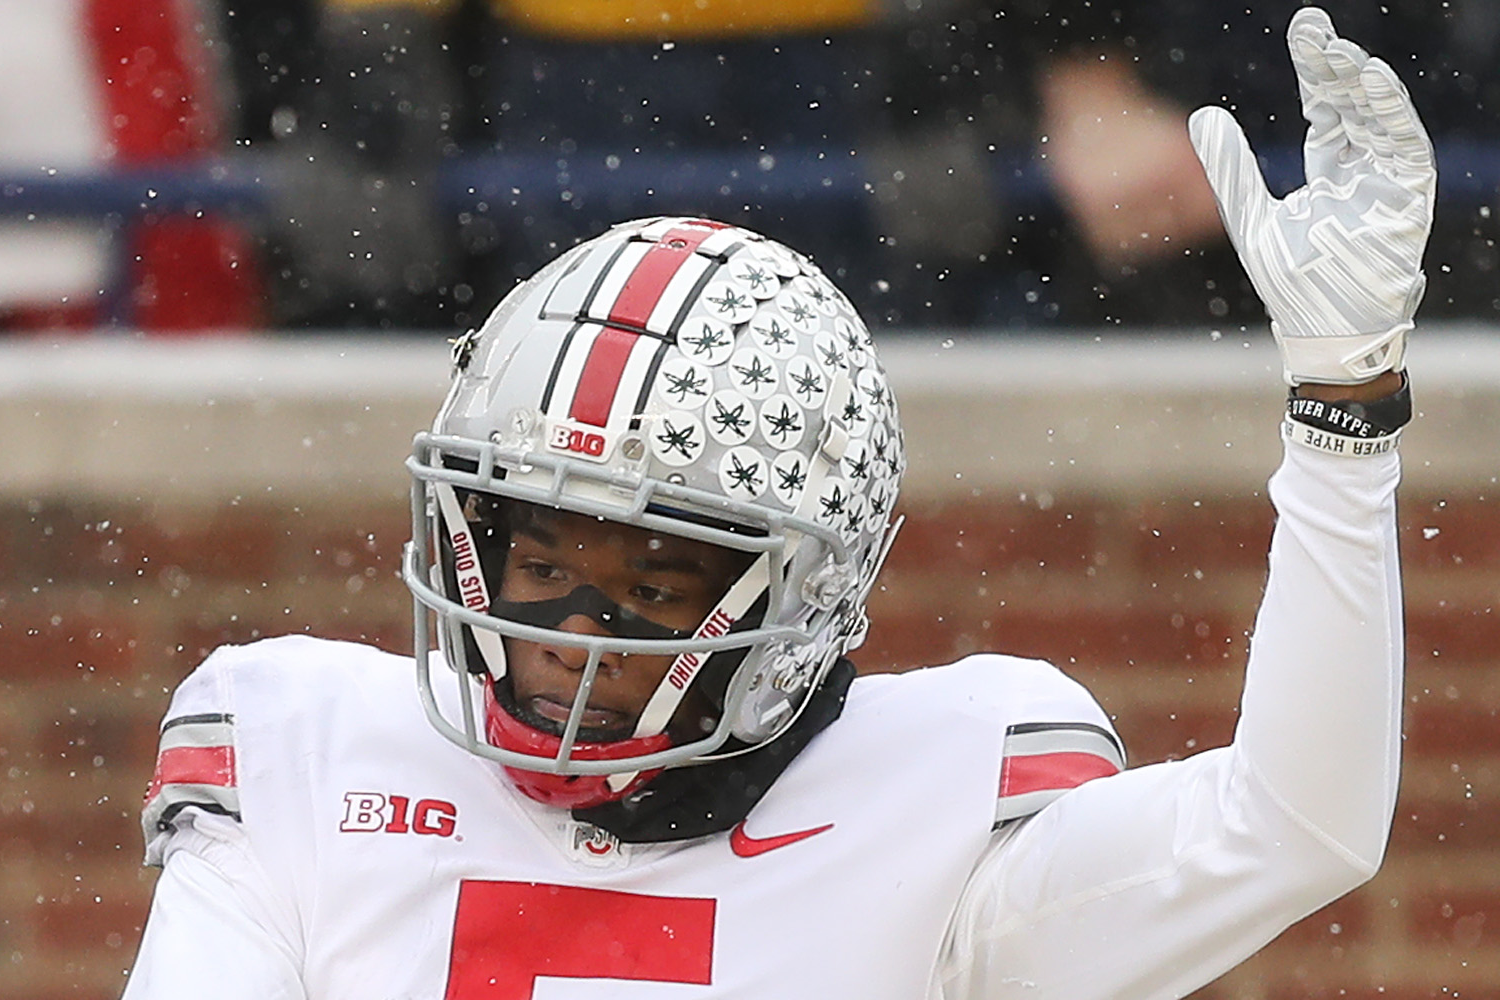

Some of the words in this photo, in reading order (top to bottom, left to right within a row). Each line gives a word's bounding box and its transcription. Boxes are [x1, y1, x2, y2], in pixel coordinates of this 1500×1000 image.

[1292, 400, 1325, 418] OVER
[1328, 407, 1372, 437] HYPE
[1304, 429, 1346, 453] HYPE
[1352, 439, 1391, 455] OVER
[452, 531, 475, 572] OHIO
[668, 652, 699, 691] OHIO
